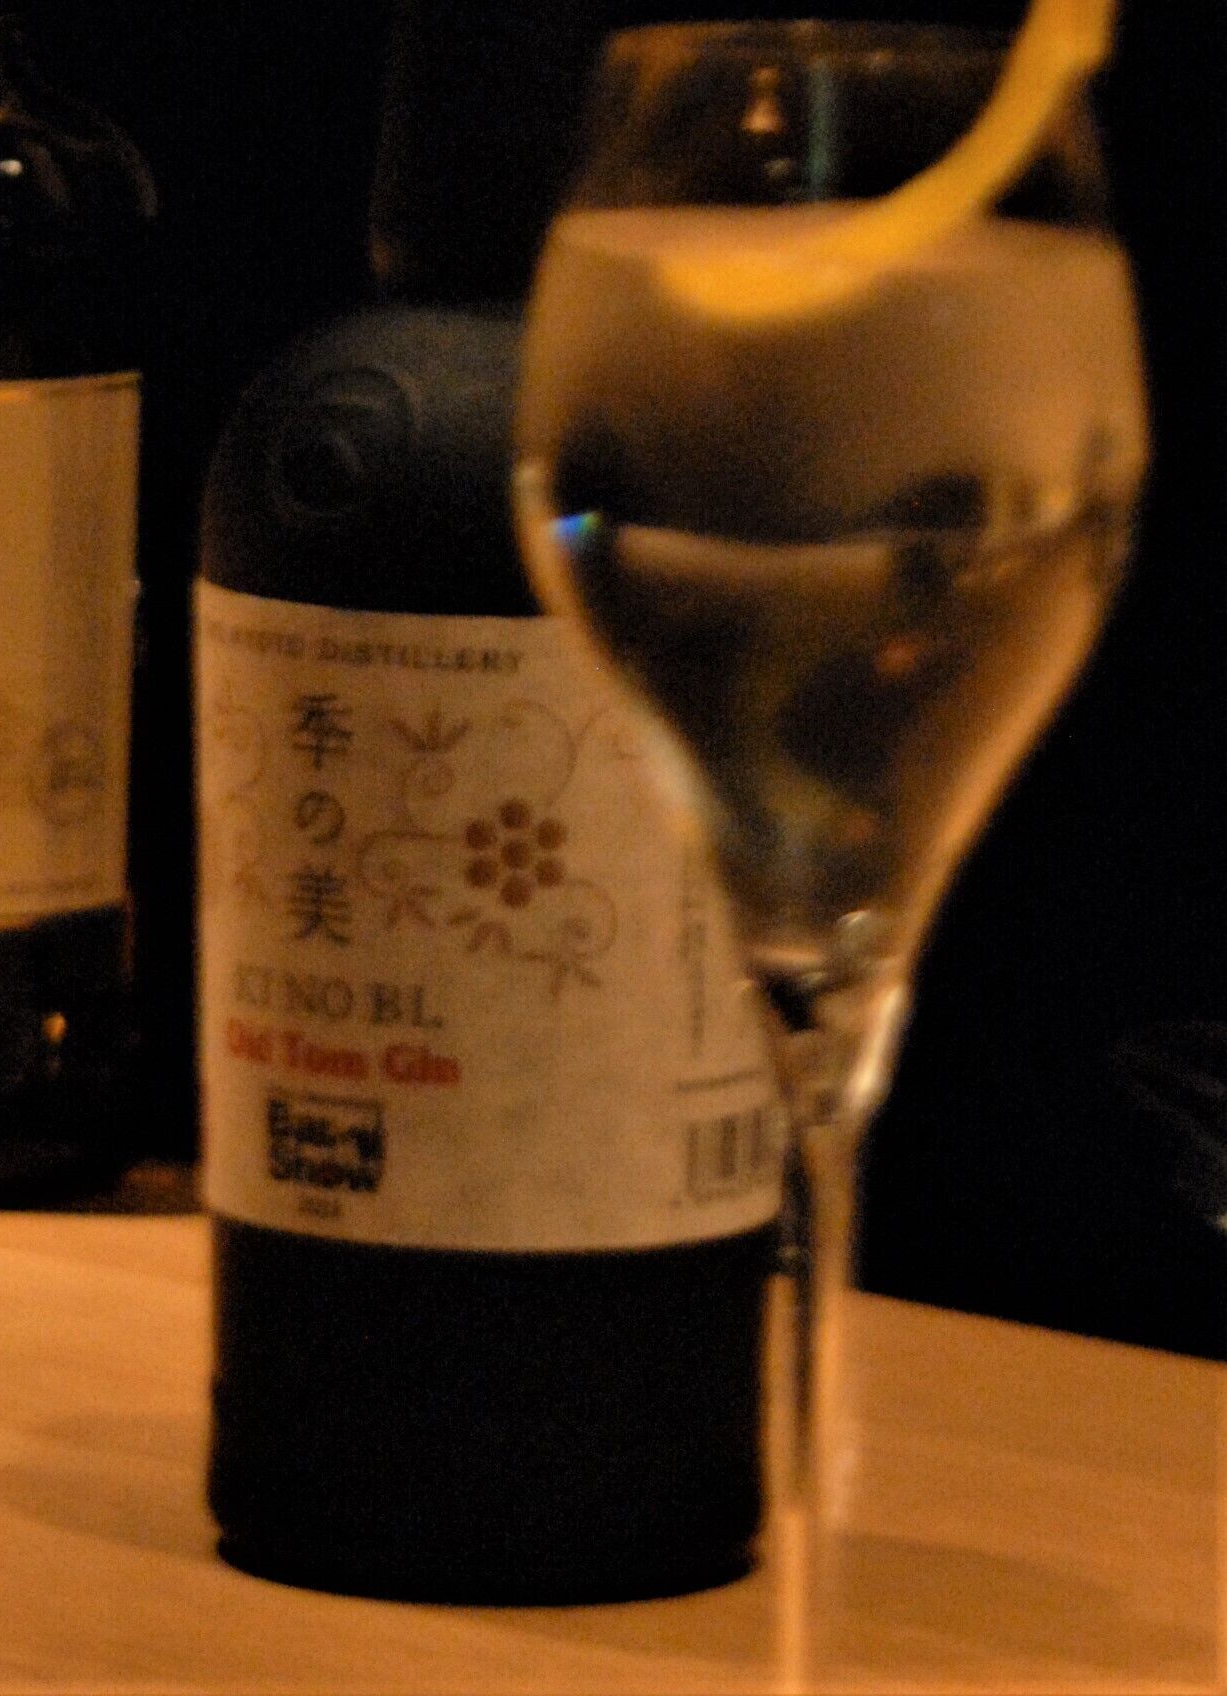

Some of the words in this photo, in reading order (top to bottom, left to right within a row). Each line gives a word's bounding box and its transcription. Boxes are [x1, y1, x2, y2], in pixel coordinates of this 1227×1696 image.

[316, 637, 525, 674] DISTILLERY
[290, 693, 355, 949] 季の美
[284, 971, 355, 1020] NO
[380, 1042, 463, 1086] Gin
